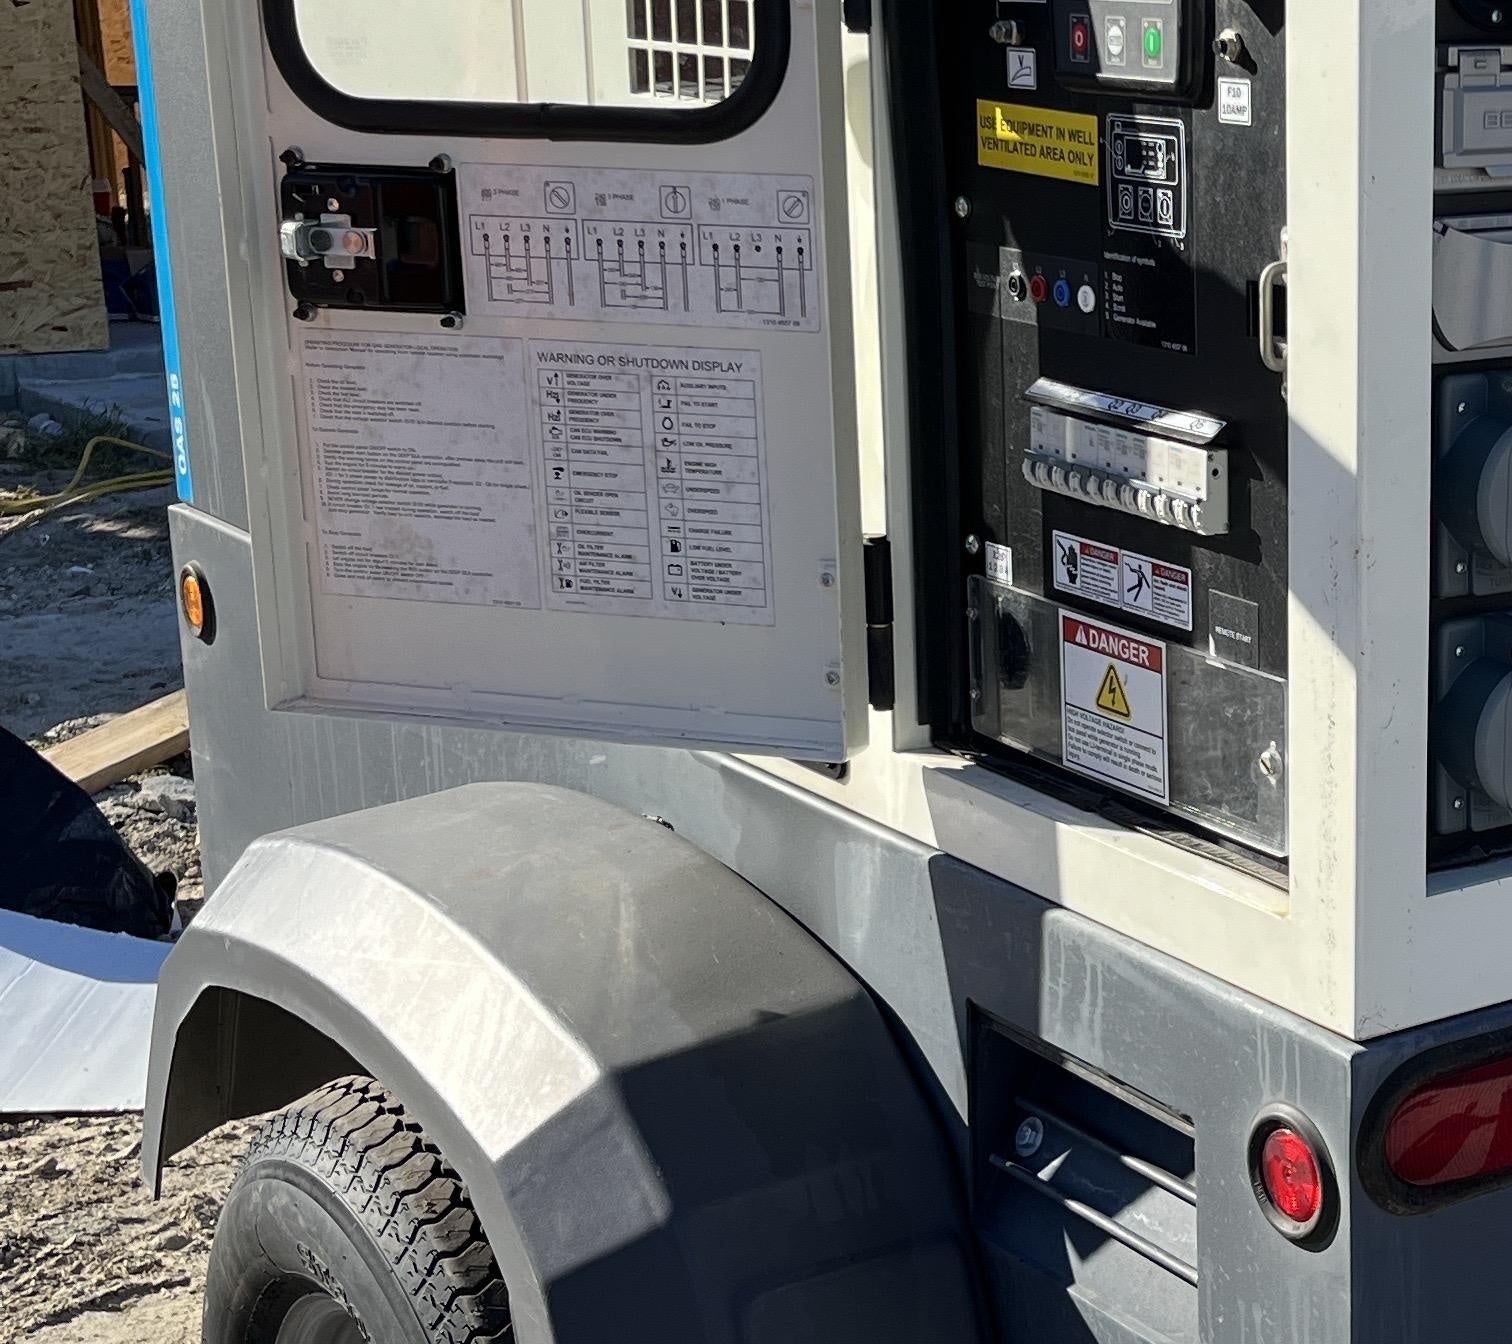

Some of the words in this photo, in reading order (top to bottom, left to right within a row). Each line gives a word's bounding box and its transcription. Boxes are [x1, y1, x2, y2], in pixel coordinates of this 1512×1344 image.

[1228, 87, 1242, 98] F10
[981, 115, 997, 130] USE
[1001, 119, 1054, 139] EQUIPMENT
[1056, 128, 1066, 142] IN
[1068, 129, 1095, 146] WELL
[981, 136, 1037, 158] VENTILATED
[1039, 145, 1066, 162] AREA
[1068, 150, 1095, 167] ONLY
[475, 223, 486, 231] L1
[500, 223, 511, 232] L2
[520, 224, 531, 233] L3
[543, 225, 550, 233] N
[587, 227, 598, 236] L1
[614, 228, 625, 237] L2
[634, 229, 646, 238] L3
[658, 229, 665, 238] N
[703, 232, 714, 241] L1
[729, 233, 741, 243] L2
[751, 234, 763, 243] L3
[775, 234, 782, 243] N
[537, 352, 595, 366] WARNING
[598, 355, 616, 367] OR
[619, 357, 690, 370] SHUTDOWN
[692, 360, 743, 374] DISPLAY
[1090, 547, 1115, 561] DANGER
[1161, 568, 1186, 582] DANGER
[1215, 626, 1235, 640] REMOTE
[1236, 631, 1252, 643] START
[1089, 629, 1150, 666] DANGER
